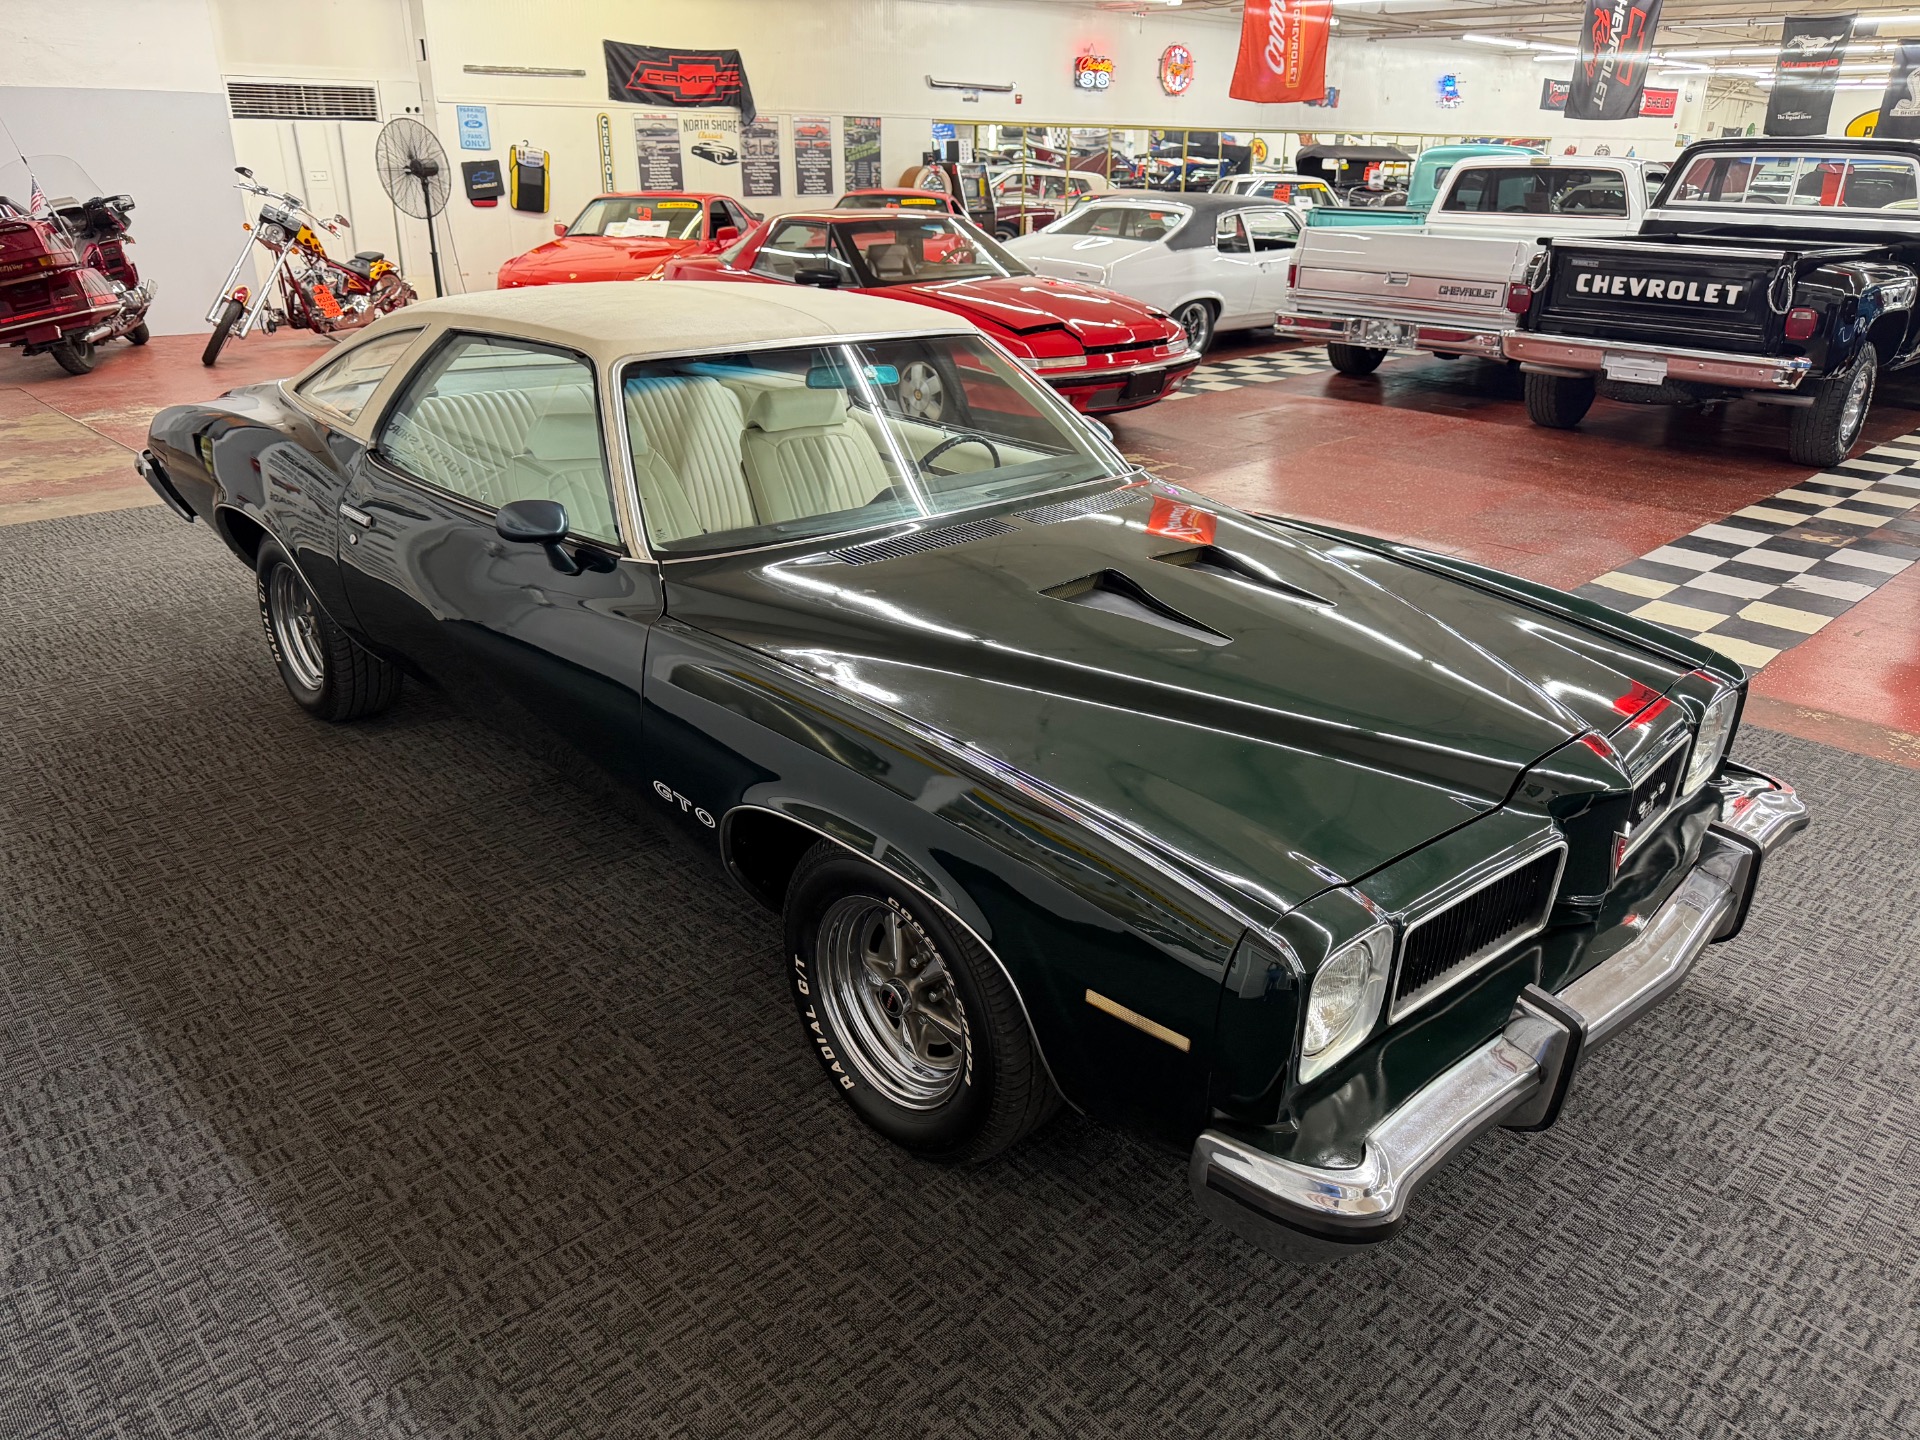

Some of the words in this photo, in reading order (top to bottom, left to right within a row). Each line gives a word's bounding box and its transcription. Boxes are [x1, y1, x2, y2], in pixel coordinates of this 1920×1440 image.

[1290, 8, 1300, 81] CHEVROLET
[1593, 0, 1628, 111] HEVROLET
[1781, 58, 1839, 68] MUSTANG
[1080, 71, 1110, 88] SS
[1646, 97, 1675, 108] SHELBY
[683, 119, 710, 132] NORTH
[711, 119, 738, 133] SHORE
[601, 117, 614, 193] CHEVROLE
[1438, 285, 1498, 299] CHEVROLET
[1575, 273, 1744, 305] CHEVROLET
[262, 608, 282, 662] RADIAL
[653, 780, 716, 829] GTO
[794, 953, 810, 995] G/T
[805, 1004, 856, 1091] RADIAL
